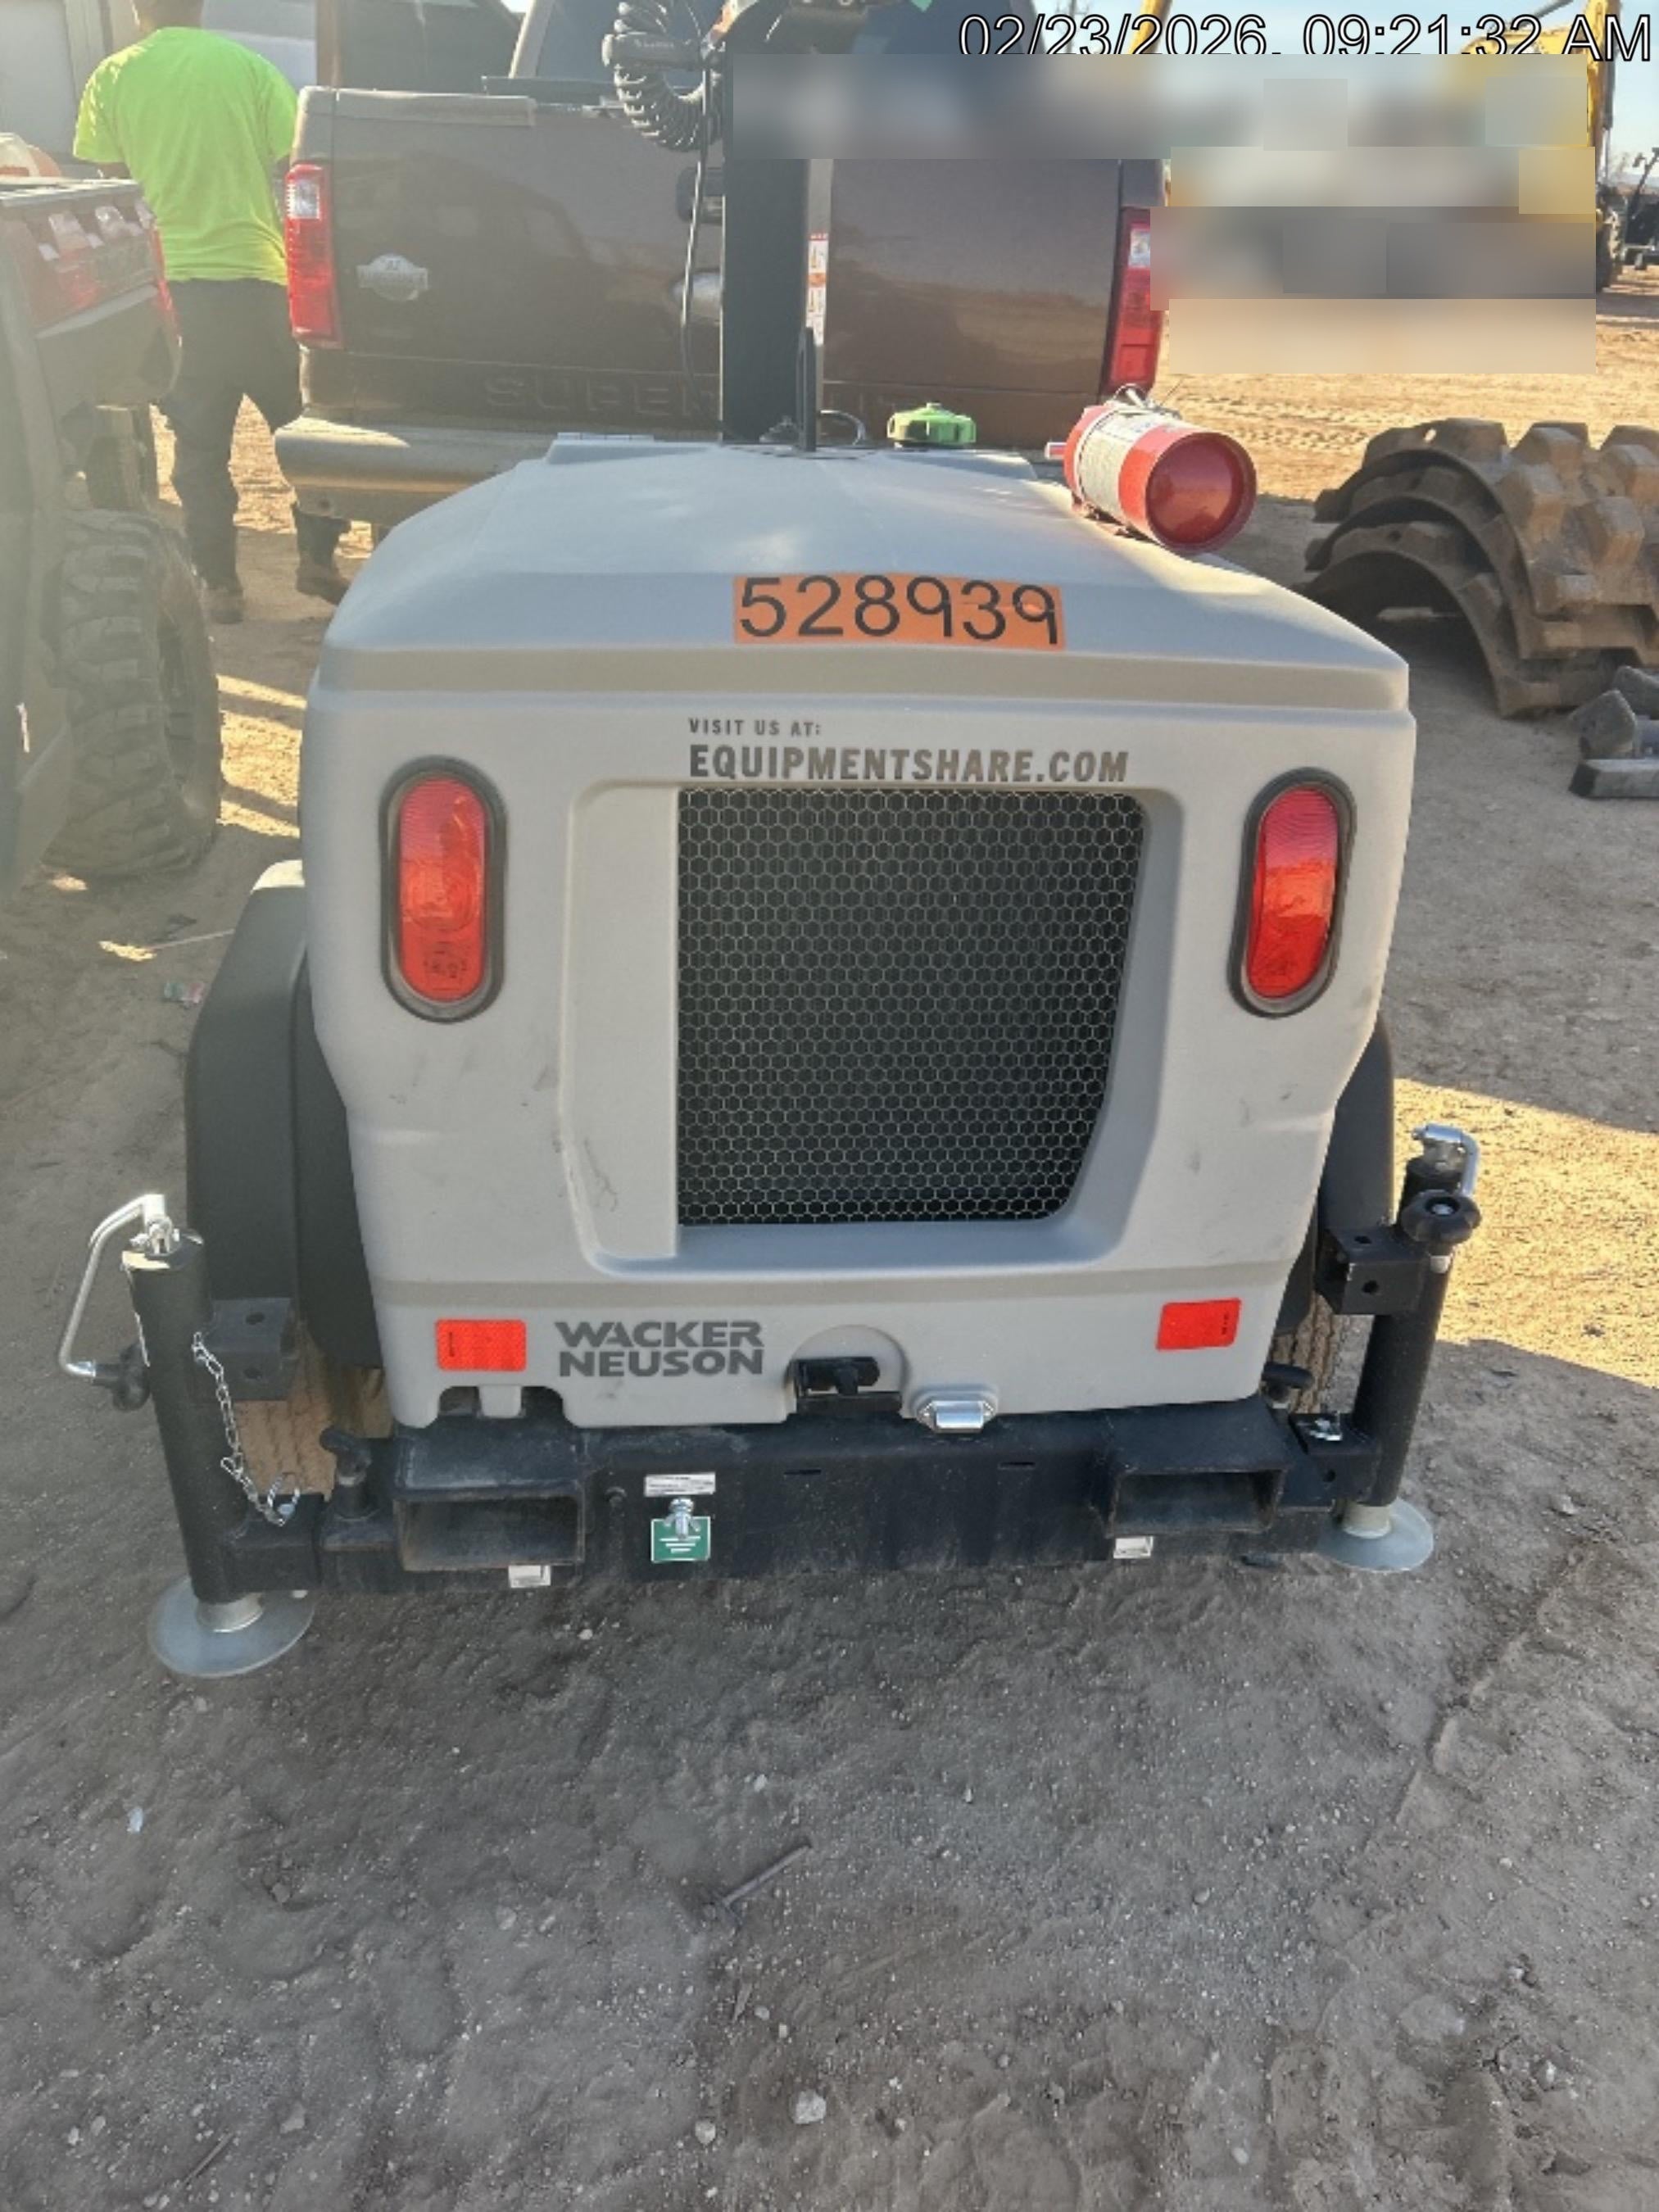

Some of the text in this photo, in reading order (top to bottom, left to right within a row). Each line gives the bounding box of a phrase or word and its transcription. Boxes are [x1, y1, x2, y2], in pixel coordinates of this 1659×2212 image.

[740, 574, 1058, 645] 528939
[688, 718, 820, 737] VISIT US AT:
[689, 744, 1128, 782] EQUIPMENTSHARE.COM
[554, 1321, 764, 1348] WACKER
[560, 1349, 764, 1377] NEUSON
